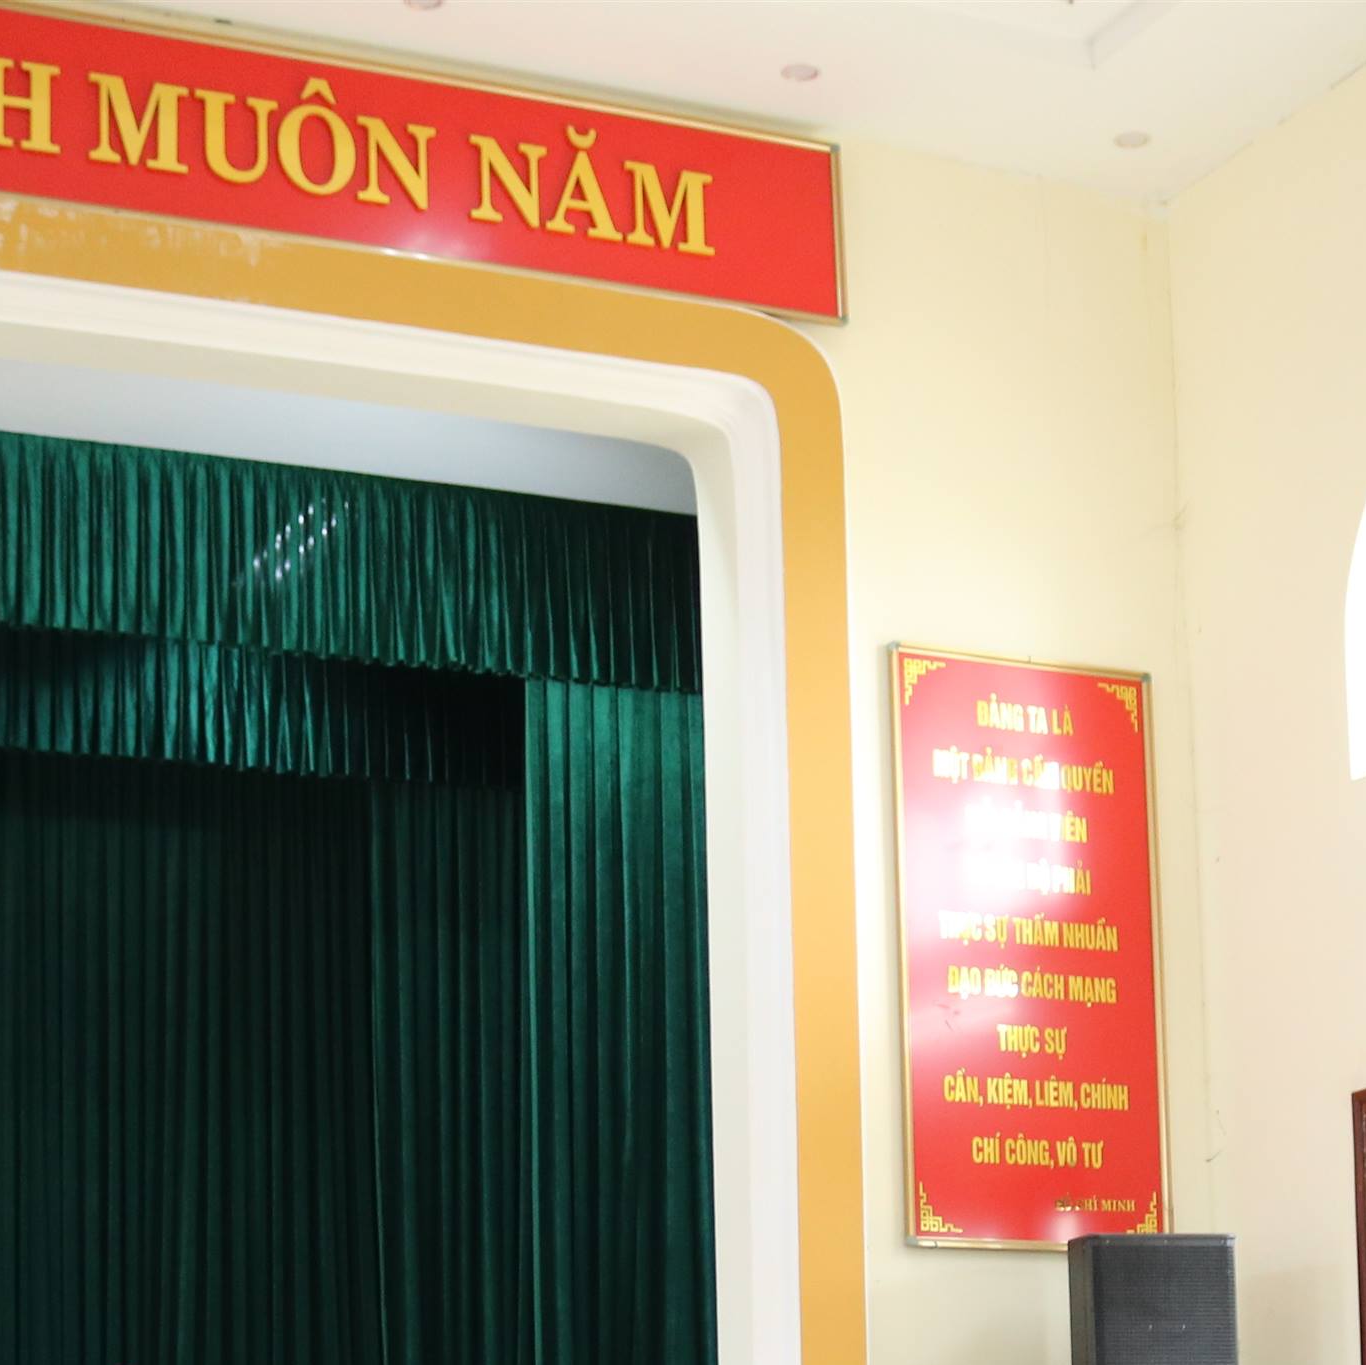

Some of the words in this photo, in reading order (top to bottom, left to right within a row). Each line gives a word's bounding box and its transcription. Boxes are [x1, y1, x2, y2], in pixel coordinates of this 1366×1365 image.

[88, 72, 435, 210] MUÔN
[468, 125, 717, 256] NĂM
[977, 692, 1024, 732] ĐẢNG
[1027, 704, 1048, 735] TA
[1051, 705, 1073, 736] LÀ
[1061, 761, 1114, 794] QUYỀN
[985, 914, 1009, 949] SỰ
[1013, 912, 1059, 946] THẤM
[948, 965, 981, 1000] ĐẠO
[1021, 966, 1064, 1000] CÁCH
[1069, 975, 1117, 1008] MẠNG
[997, 1024, 1040, 1058] THỰC
[1045, 1027, 1067, 1060] SỰ
[944, 1067, 984, 1107] CẦN,
[987, 1072, 1033, 1110] KIỆM,
[1035, 1075, 1078, 1111] LIÊM,
[1080, 1078, 1129, 1111] CHÍNH
[972, 1132, 1000, 1164] CHÍ
[1005, 1133, 1054, 1169] CÔNG,
[1057, 1136, 1077, 1167] VÔ
[1082, 1140, 1104, 1168] TƯ
[1101, 1199, 1136, 1212] MINH
